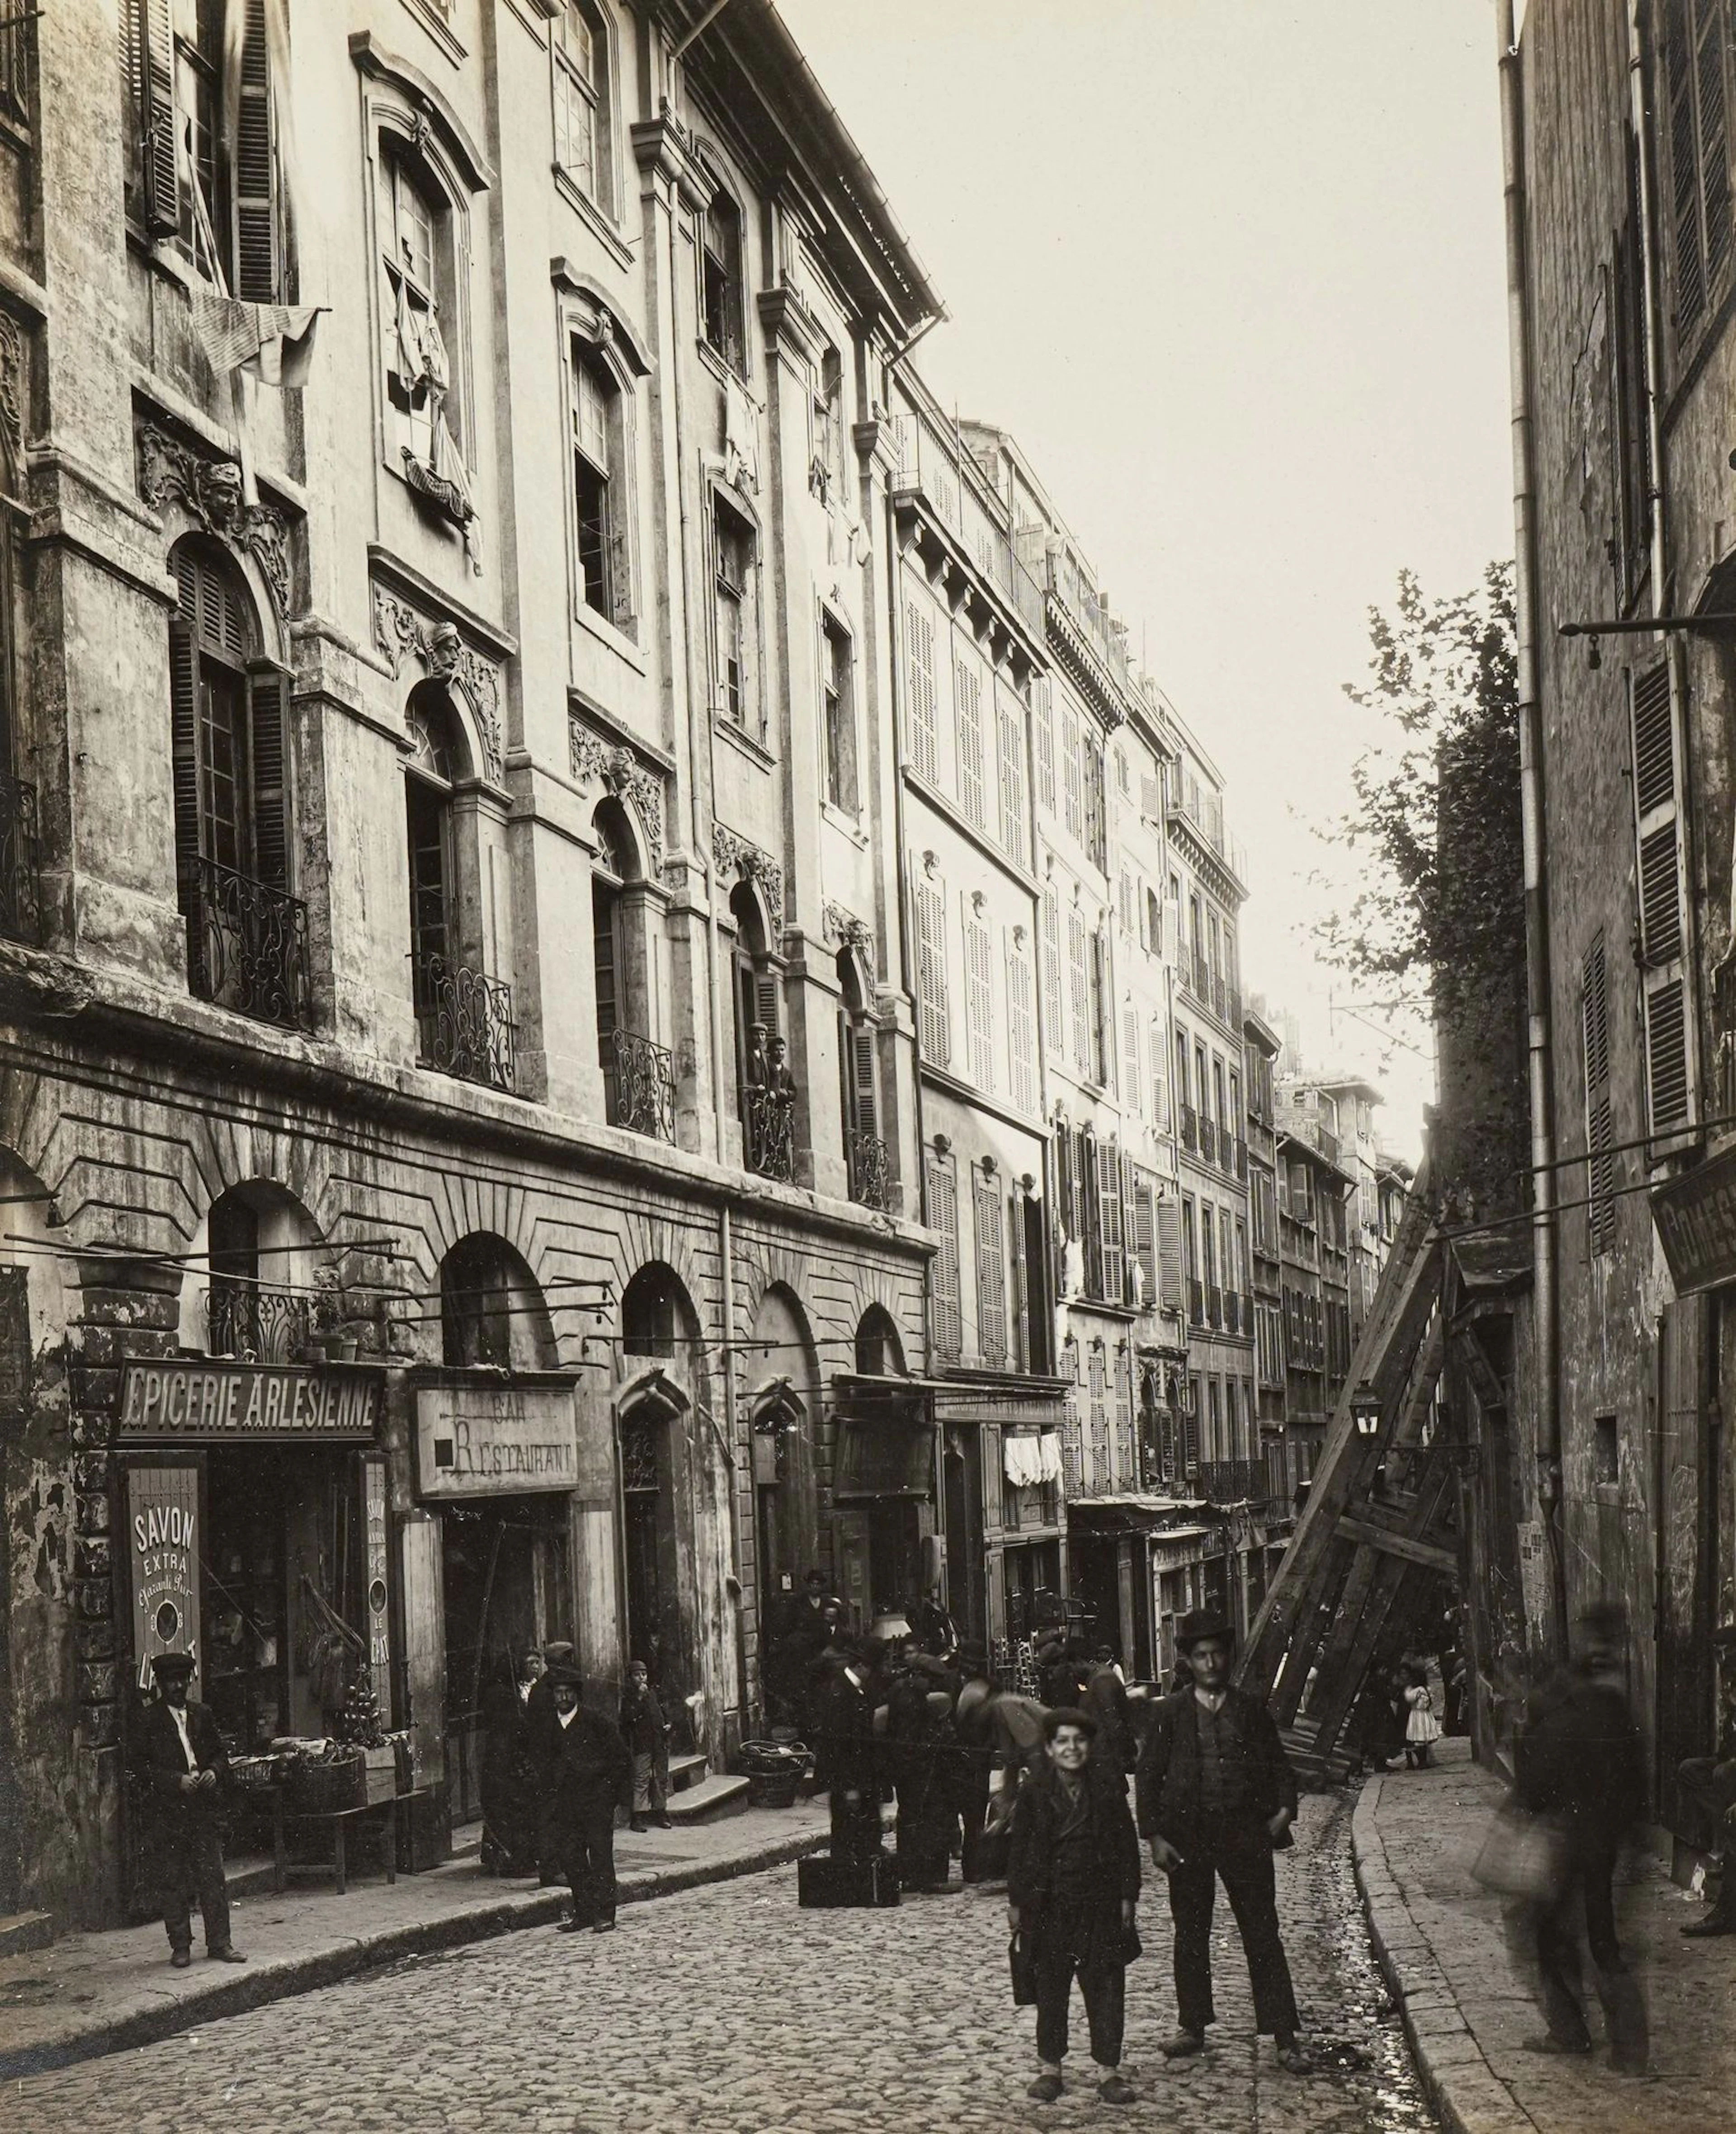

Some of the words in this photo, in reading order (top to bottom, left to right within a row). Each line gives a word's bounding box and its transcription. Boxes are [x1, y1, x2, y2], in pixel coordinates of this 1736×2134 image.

[122, 1367, 242, 1427] EPICERIE
[492, 1393, 525, 1425] BAR
[135, 1506, 194, 1552] SAVON
[143, 1552, 186, 1577] EXTRA
[375, 1618, 382, 1629] LE
[371, 1634, 390, 1664] CHAT
